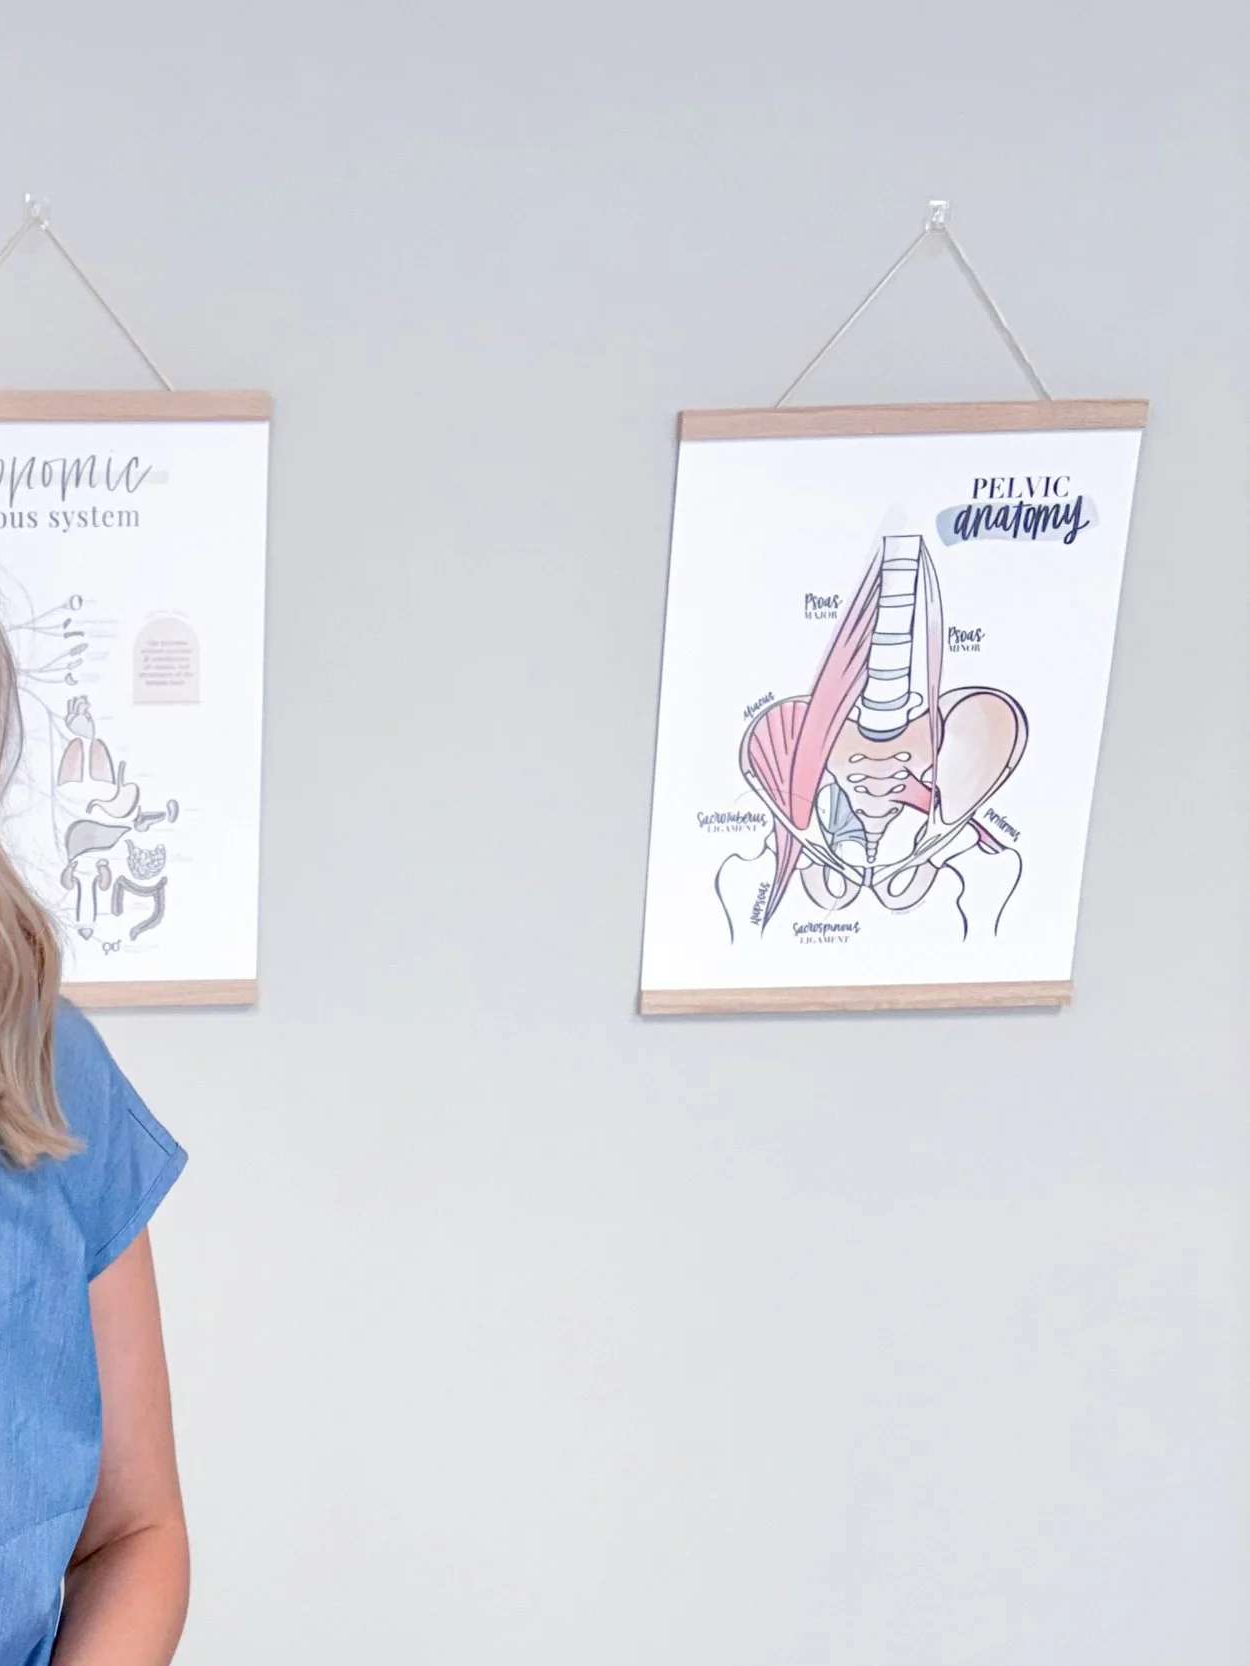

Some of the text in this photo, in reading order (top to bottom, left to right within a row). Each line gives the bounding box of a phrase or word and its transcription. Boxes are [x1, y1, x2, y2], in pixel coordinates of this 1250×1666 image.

[971, 475, 1071, 499] PELVIC
[48, 506, 140, 533] system
[953, 495, 1090, 545] anatomy
[804, 611, 838, 620] MAJOR
[948, 644, 981, 652] MINOR
